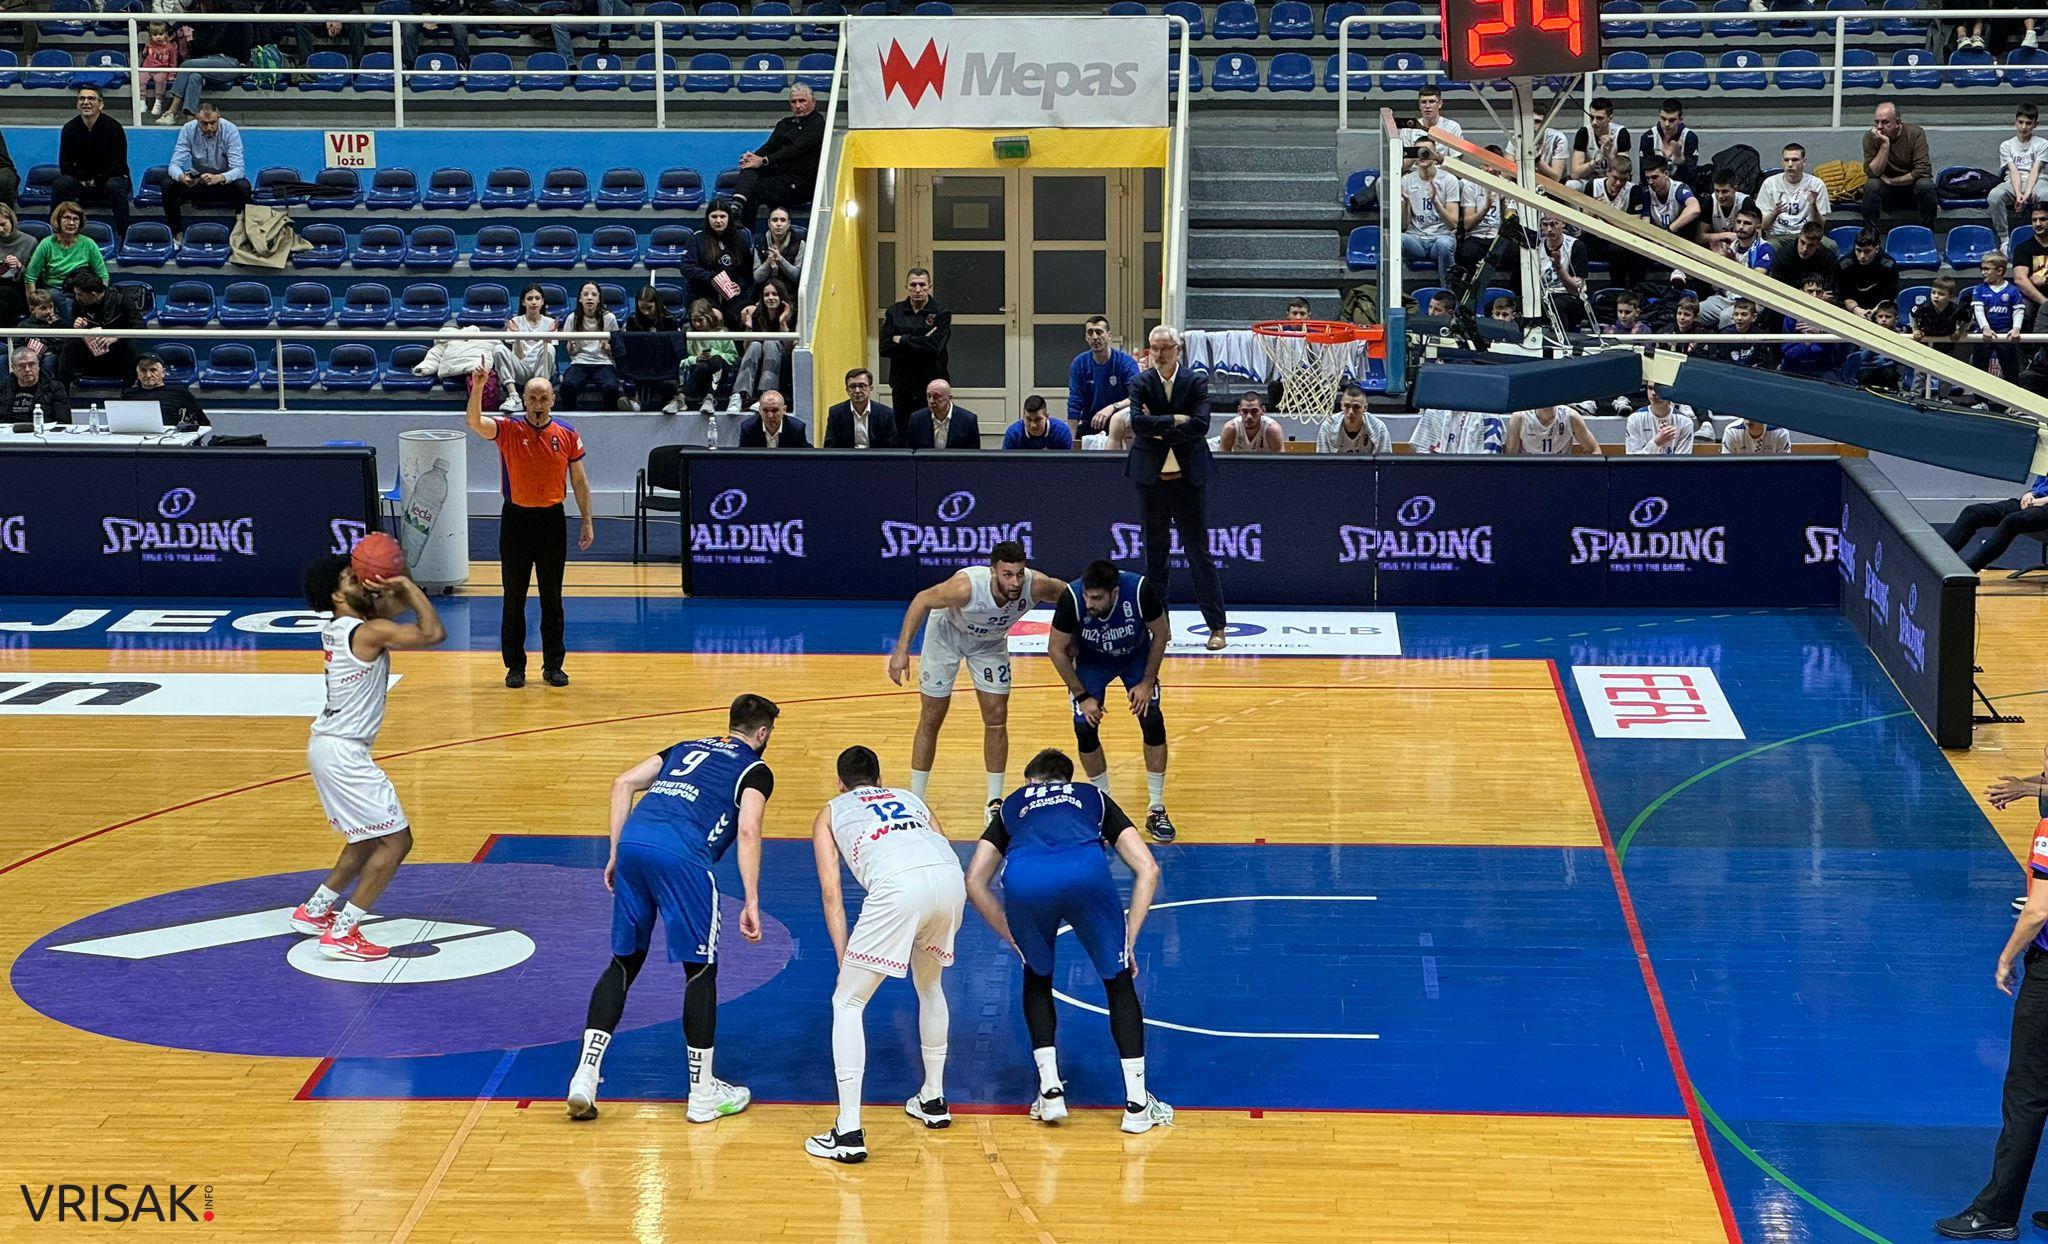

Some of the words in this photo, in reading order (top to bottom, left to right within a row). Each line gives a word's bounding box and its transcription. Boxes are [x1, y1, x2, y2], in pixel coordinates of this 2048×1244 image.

[1467, 0, 1582, 67] 24
[960, 52, 1139, 110] Mepas
[330, 134, 369, 153] VIP
[337, 155, 365, 166] loža
[103, 517, 255, 555] SPALDING
[1339, 525, 1493, 563] SPALDING
[1570, 527, 1726, 564] SPALDING
[1282, 626, 1382, 635] NLB
[669, 750, 711, 777] 9
[1024, 784, 1074, 798] 44
[865, 801, 913, 822] 12
